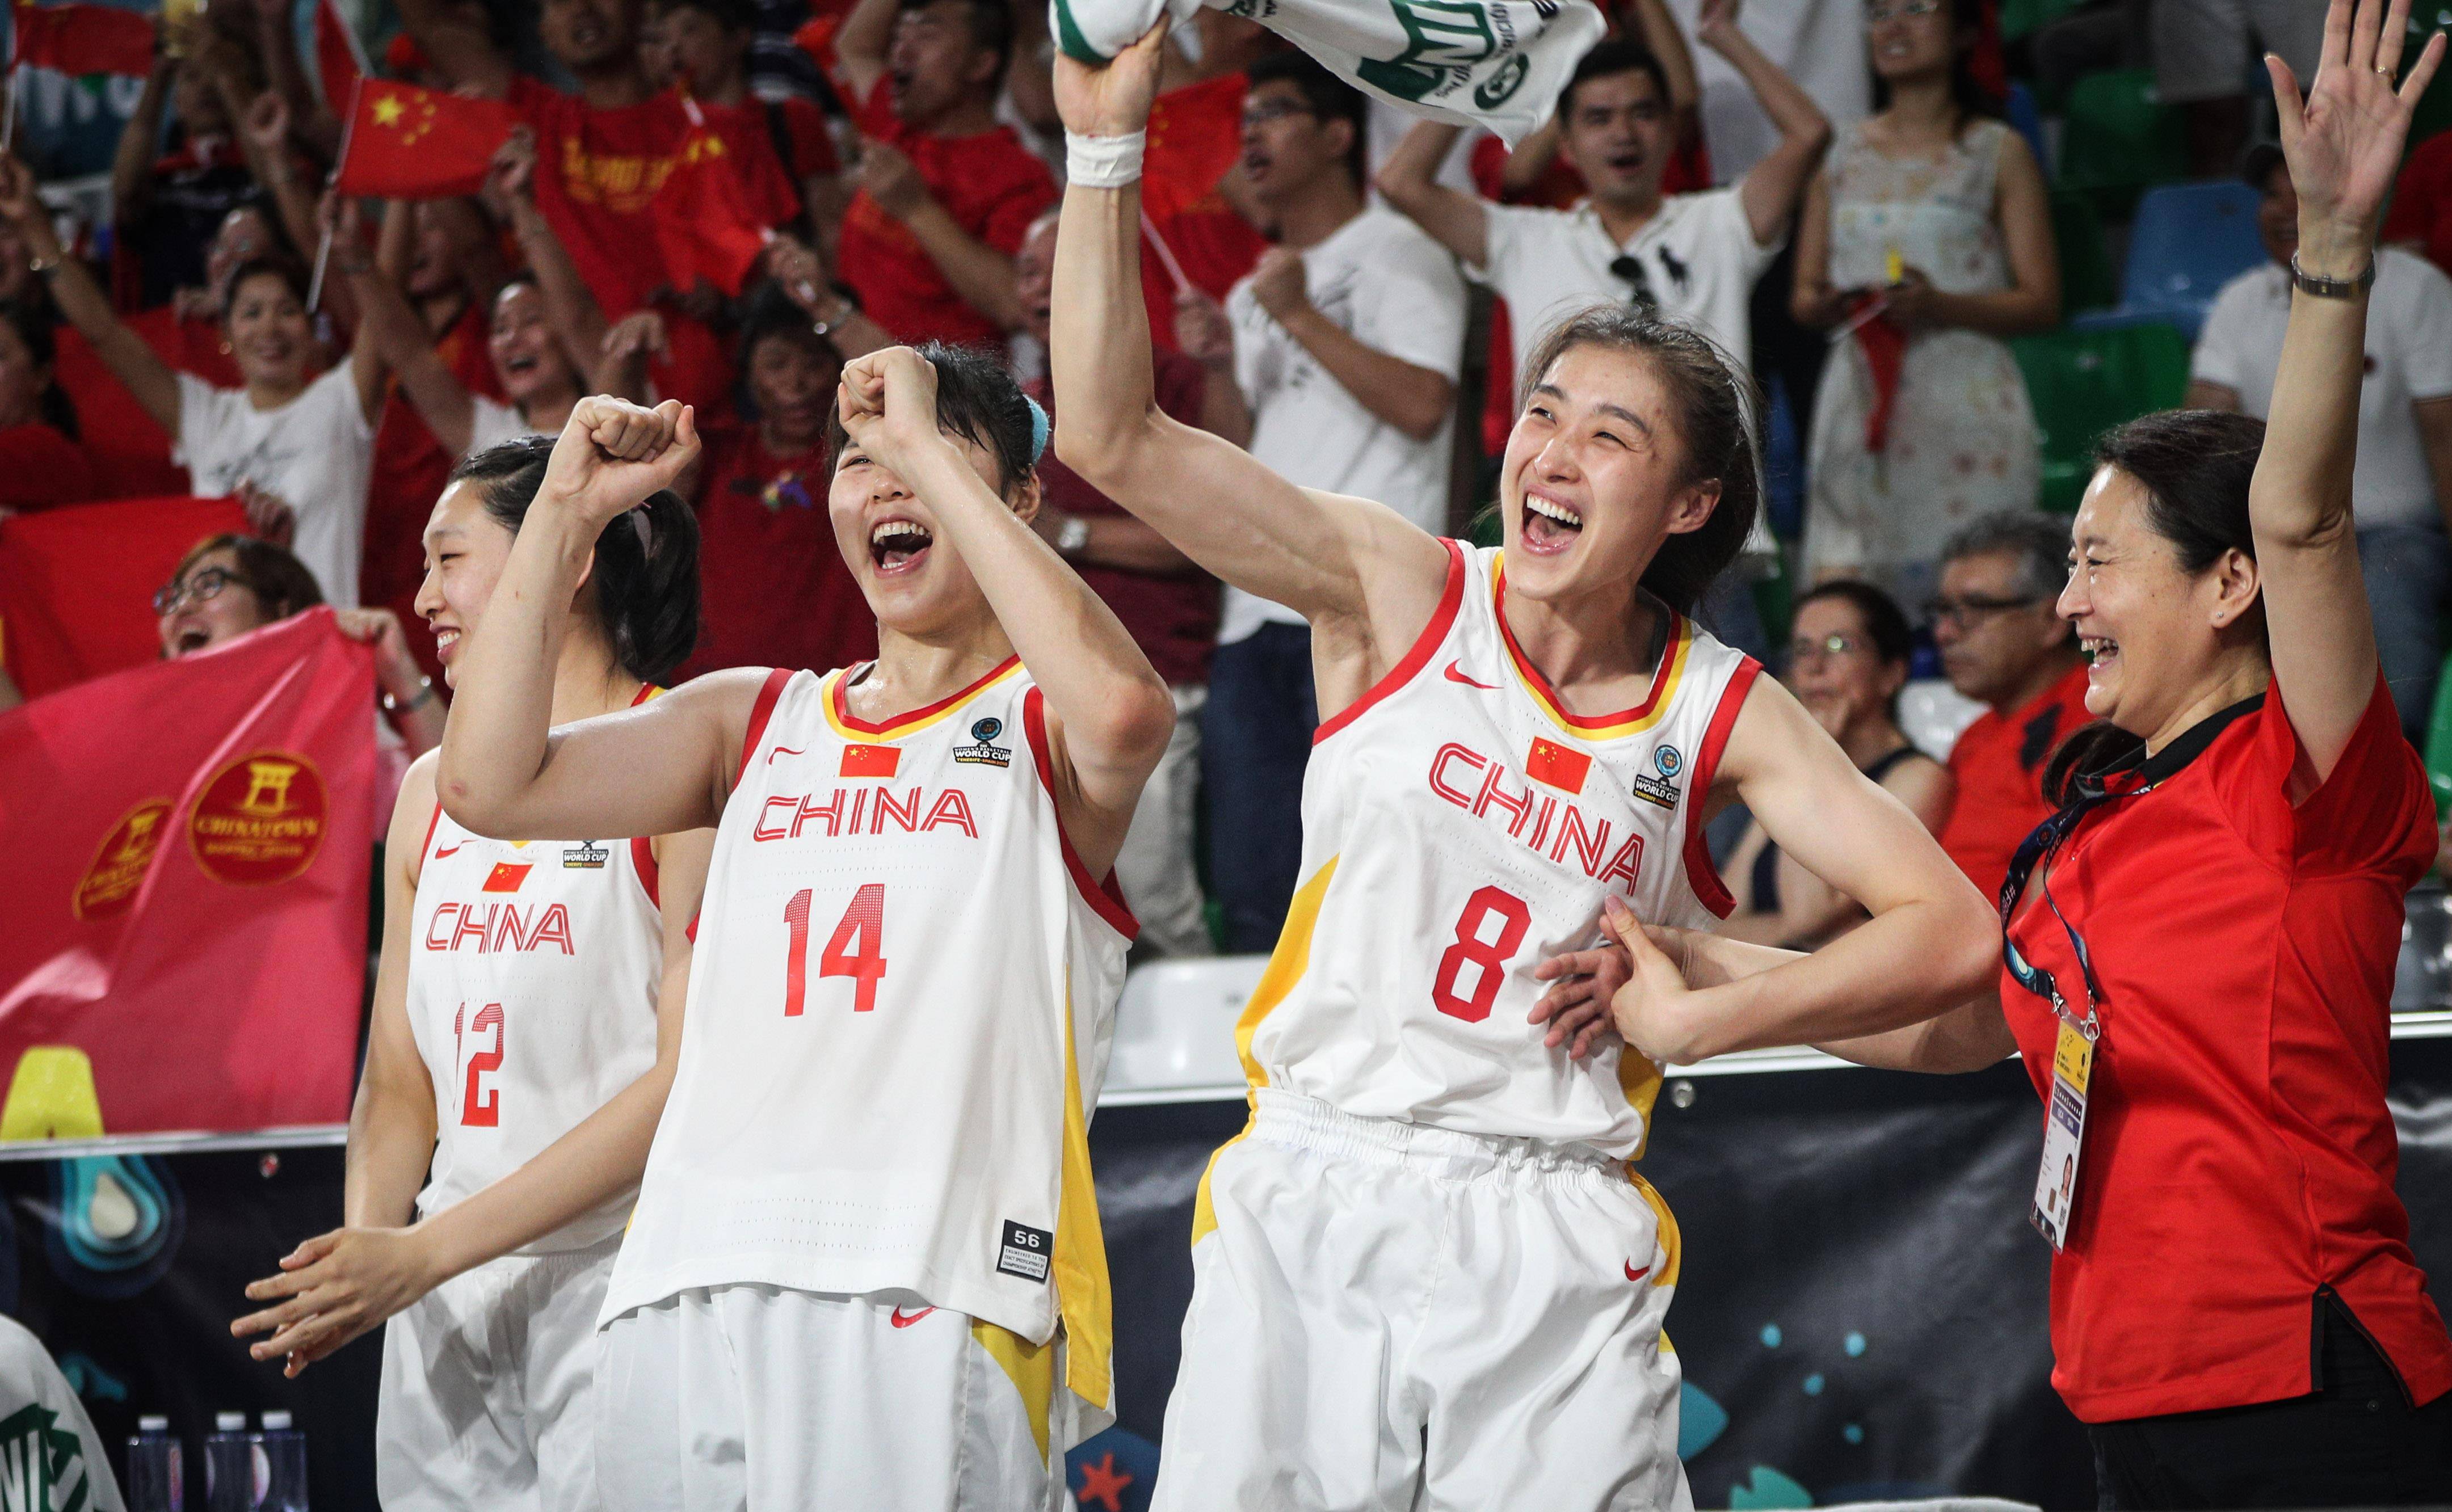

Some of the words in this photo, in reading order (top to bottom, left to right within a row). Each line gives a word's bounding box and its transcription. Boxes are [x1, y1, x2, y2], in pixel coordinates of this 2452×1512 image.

[991, 752, 1011, 761] CUP
[753, 786, 978, 842] CHINA
[1636, 780, 1665, 798] WORLD
[1666, 792, 1679, 802] CUP
[1429, 742, 1645, 897] CHINA
[426, 903, 574, 955] CHINA
[784, 883, 887, 1017] 14
[1432, 885, 1532, 1024] 8
[1015, 1230, 1040, 1248] 56
